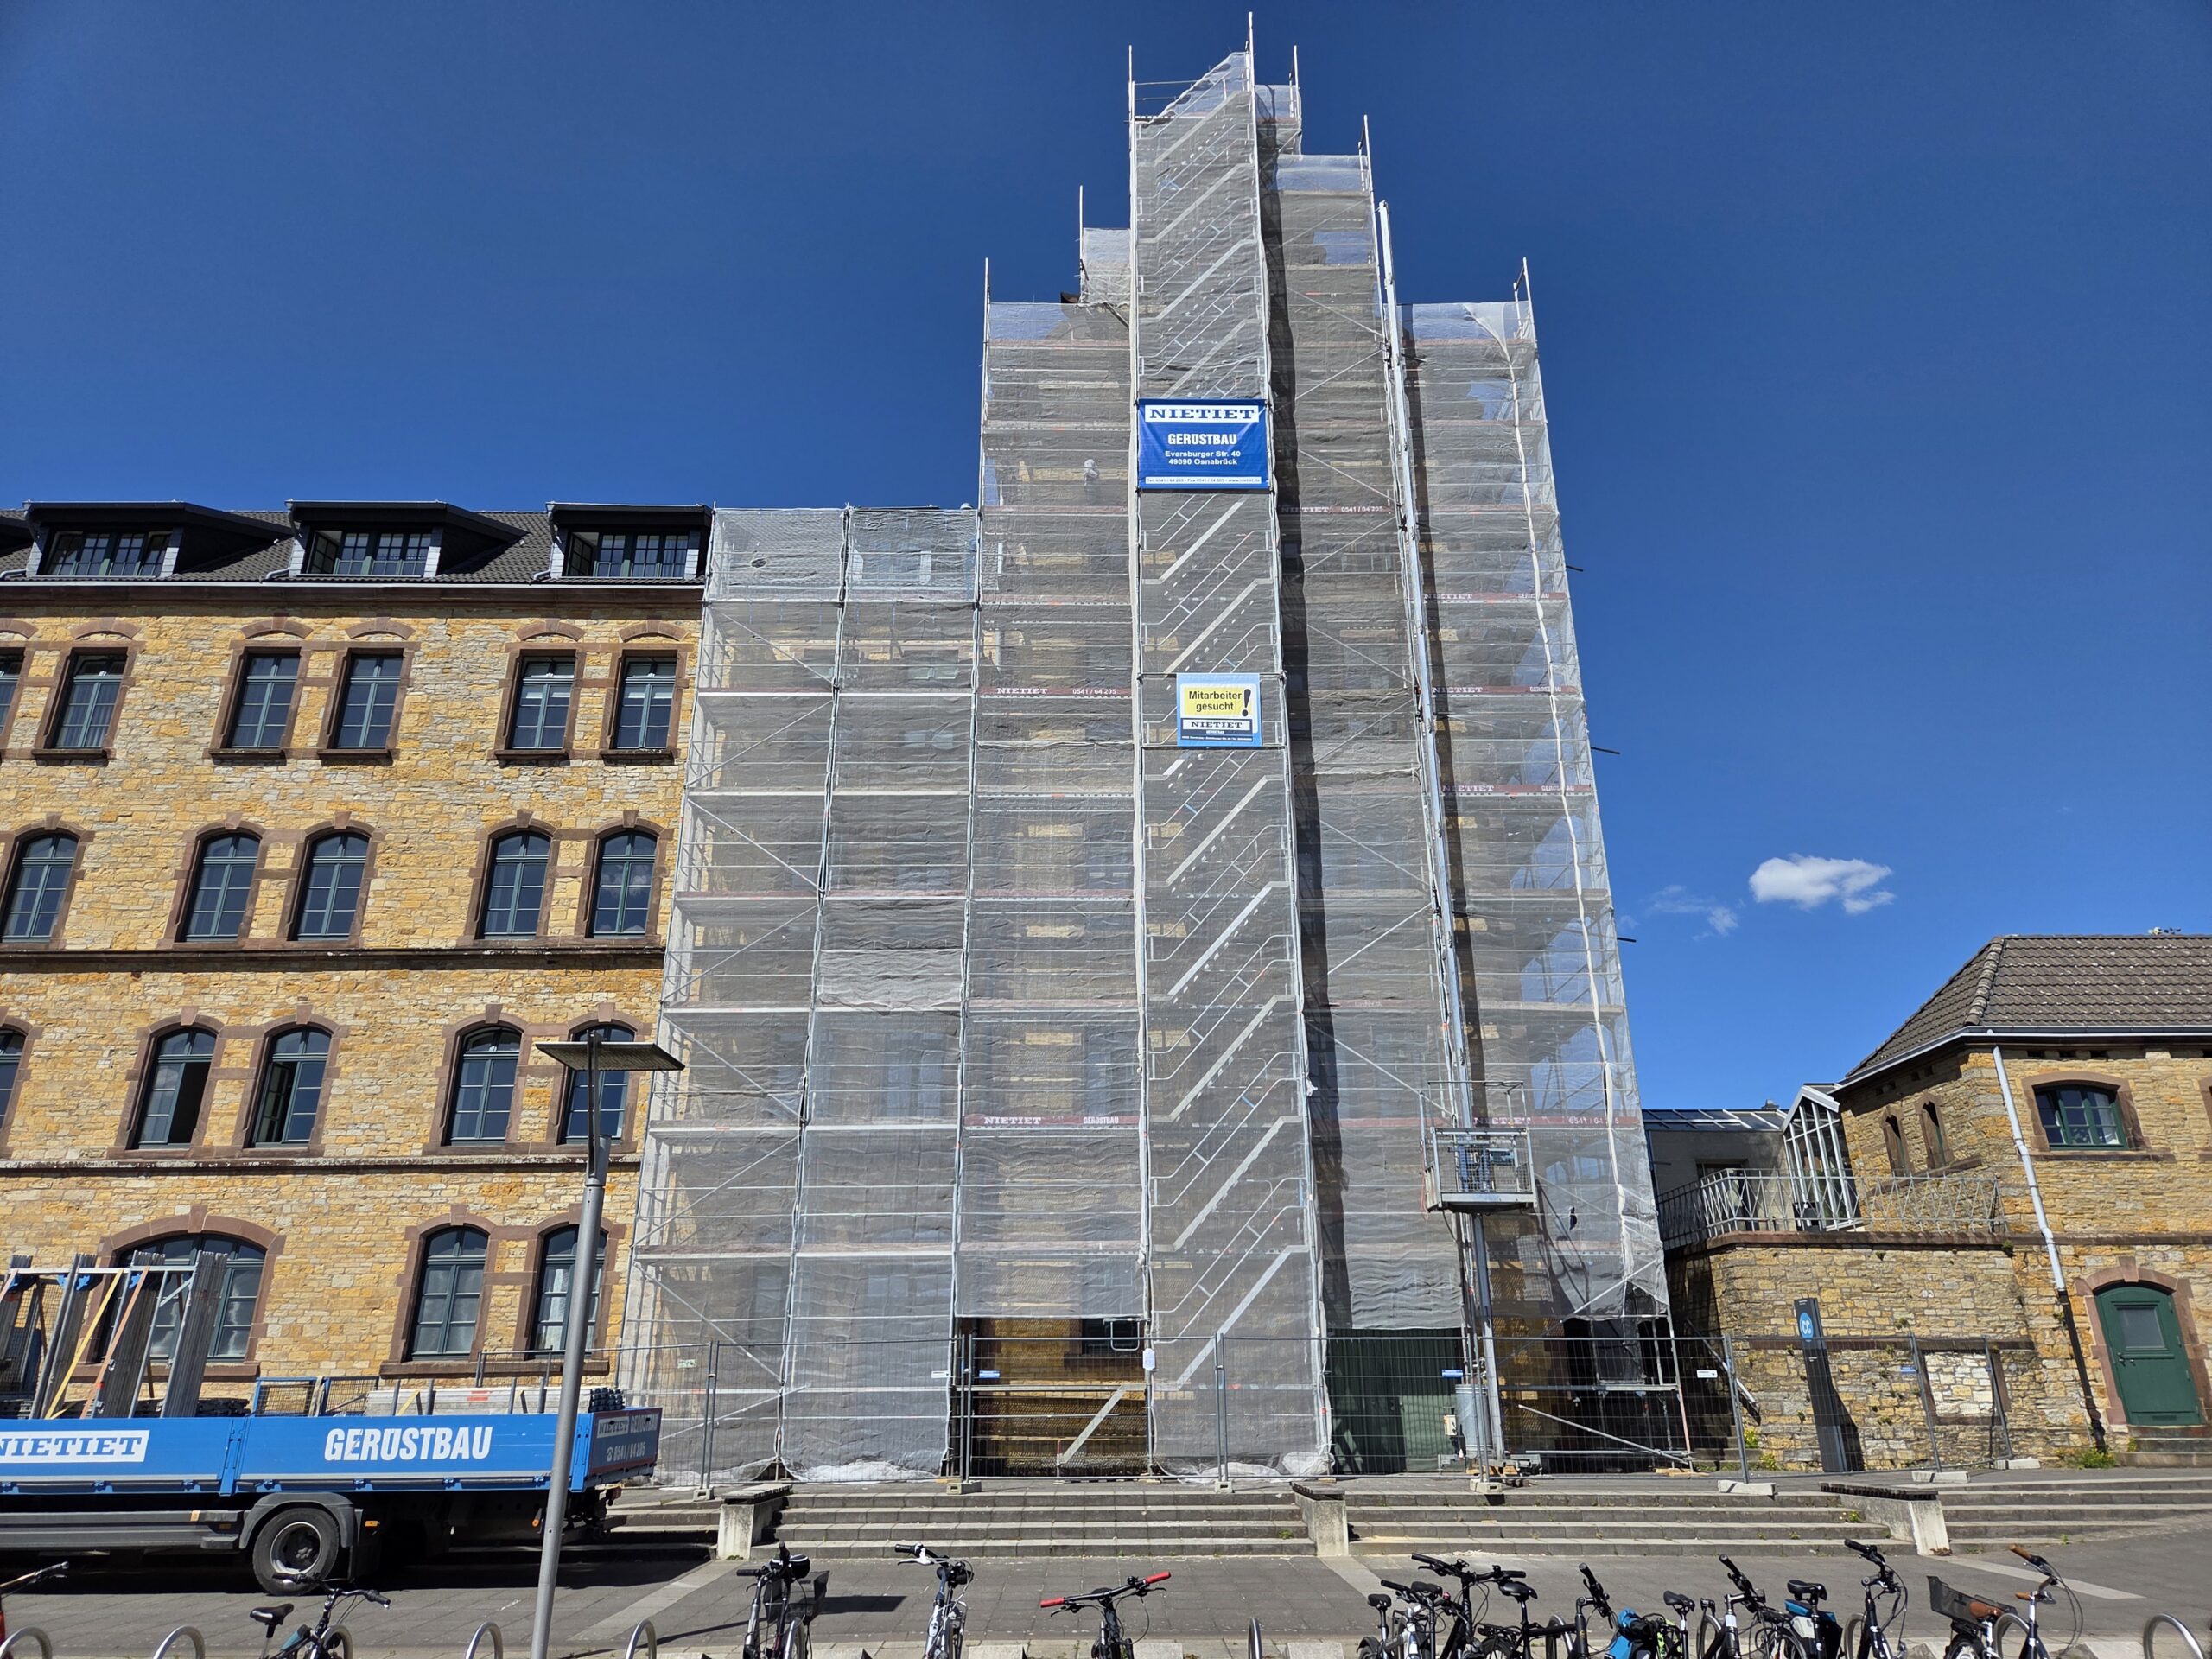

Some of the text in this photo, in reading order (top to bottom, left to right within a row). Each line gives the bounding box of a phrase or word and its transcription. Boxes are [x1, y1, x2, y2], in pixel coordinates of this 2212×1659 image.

[1149, 409, 1255, 419] NIETIET
[1167, 433, 1238, 445] GERÜSTBAU
[1165, 450, 1214, 459] Eversburger
[1189, 690, 1243, 700] Mitarbeiter
[1196, 702, 1234, 712] gesucht
[324, 1427, 493, 1461] GERÜSTBAU
